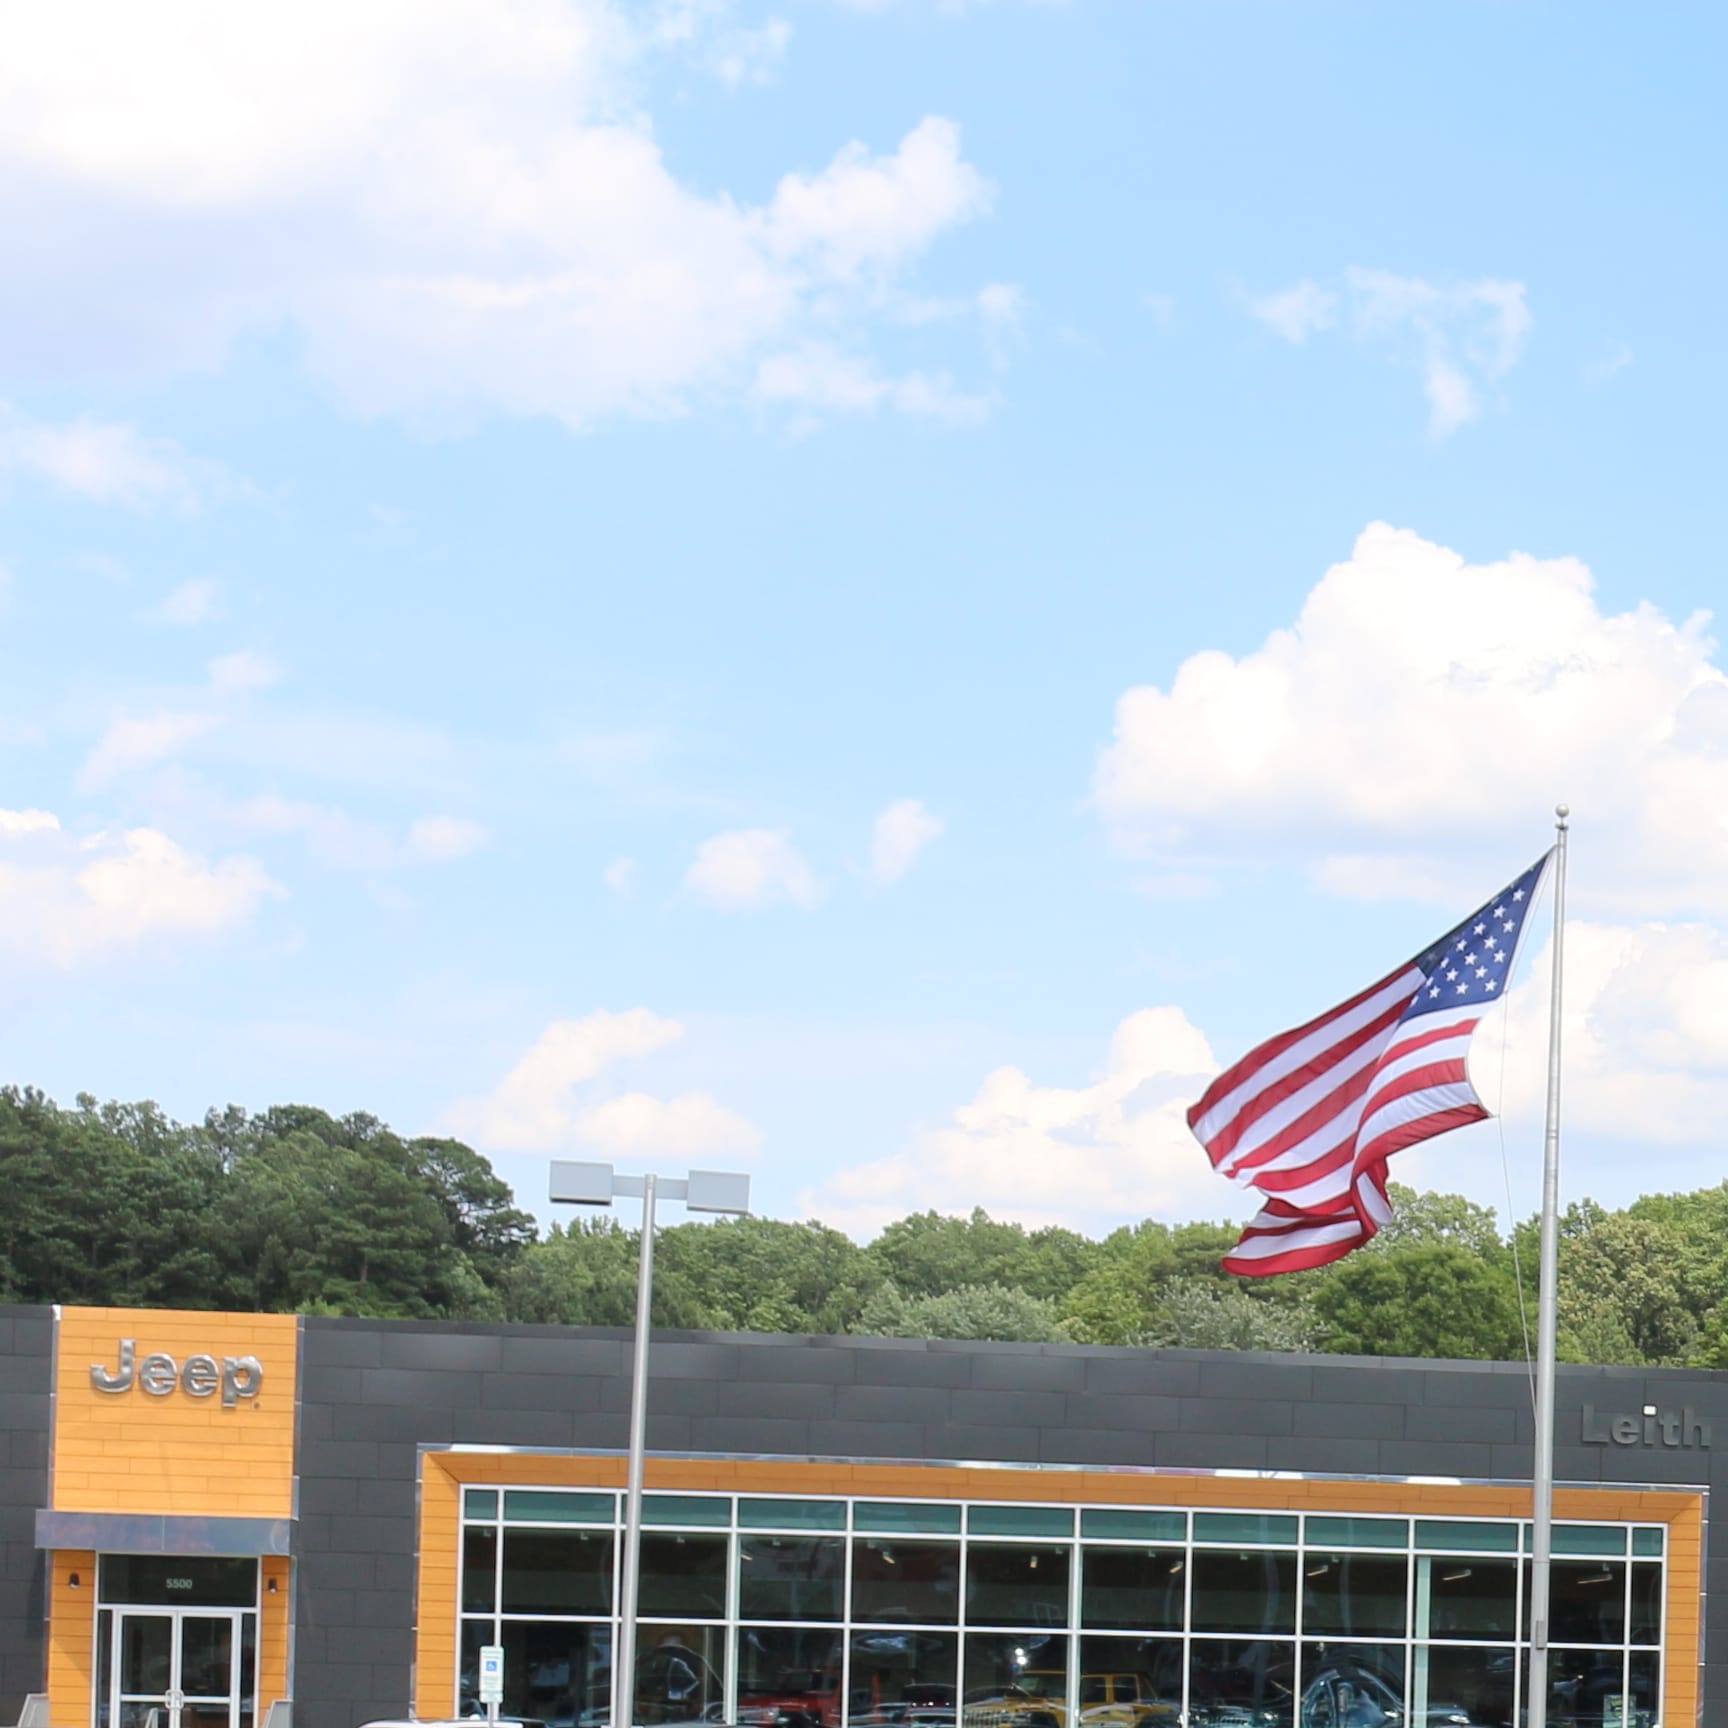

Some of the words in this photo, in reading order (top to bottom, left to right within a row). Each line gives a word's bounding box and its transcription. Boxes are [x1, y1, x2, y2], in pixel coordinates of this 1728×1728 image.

[90, 1338, 264, 1408] Jeep
[1582, 1404, 1712, 1447] Leith
[166, 1578, 193, 1590] 5500
